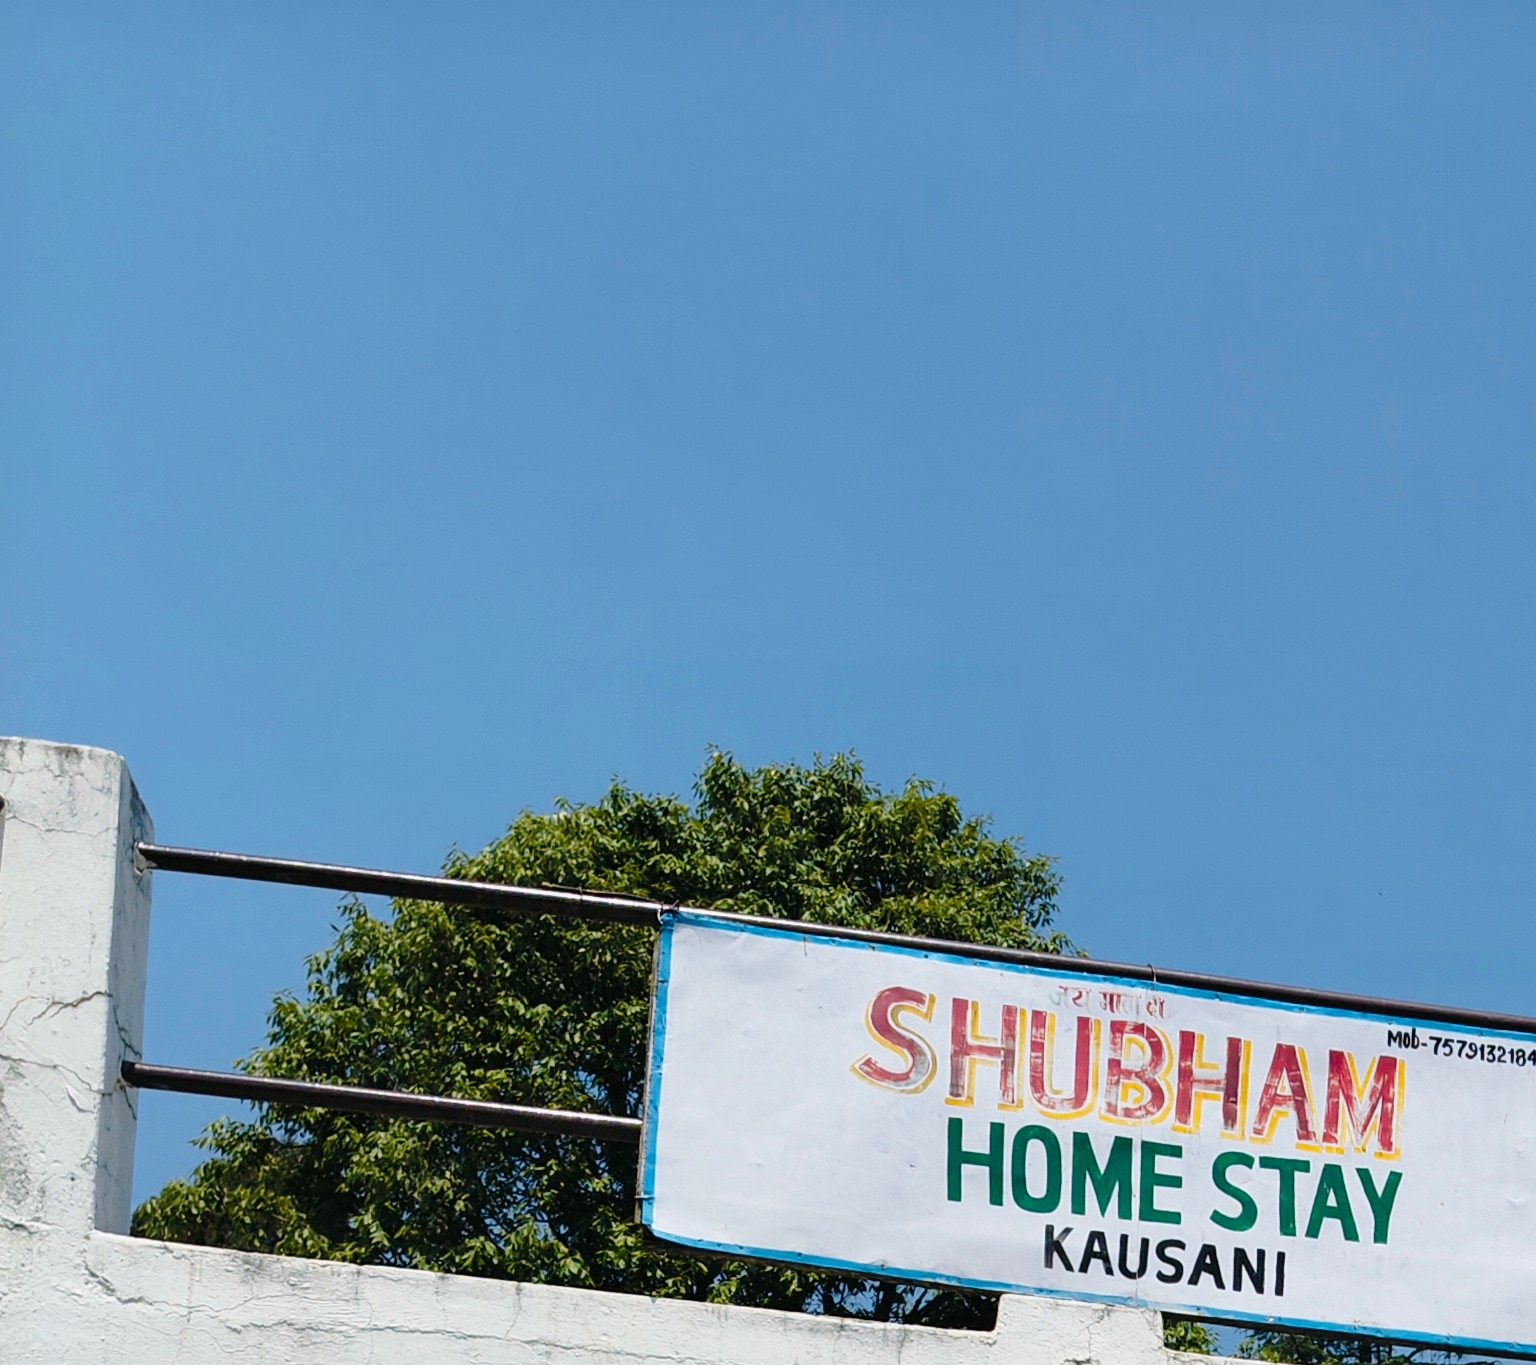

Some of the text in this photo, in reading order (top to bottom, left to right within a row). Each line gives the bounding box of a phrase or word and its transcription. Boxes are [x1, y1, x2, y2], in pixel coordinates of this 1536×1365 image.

[850, 986, 1406, 1161] SHUBHAM
[947, 1117, 1403, 1245] HOME STAY
[1044, 1224, 1286, 1297] KAUSANI
